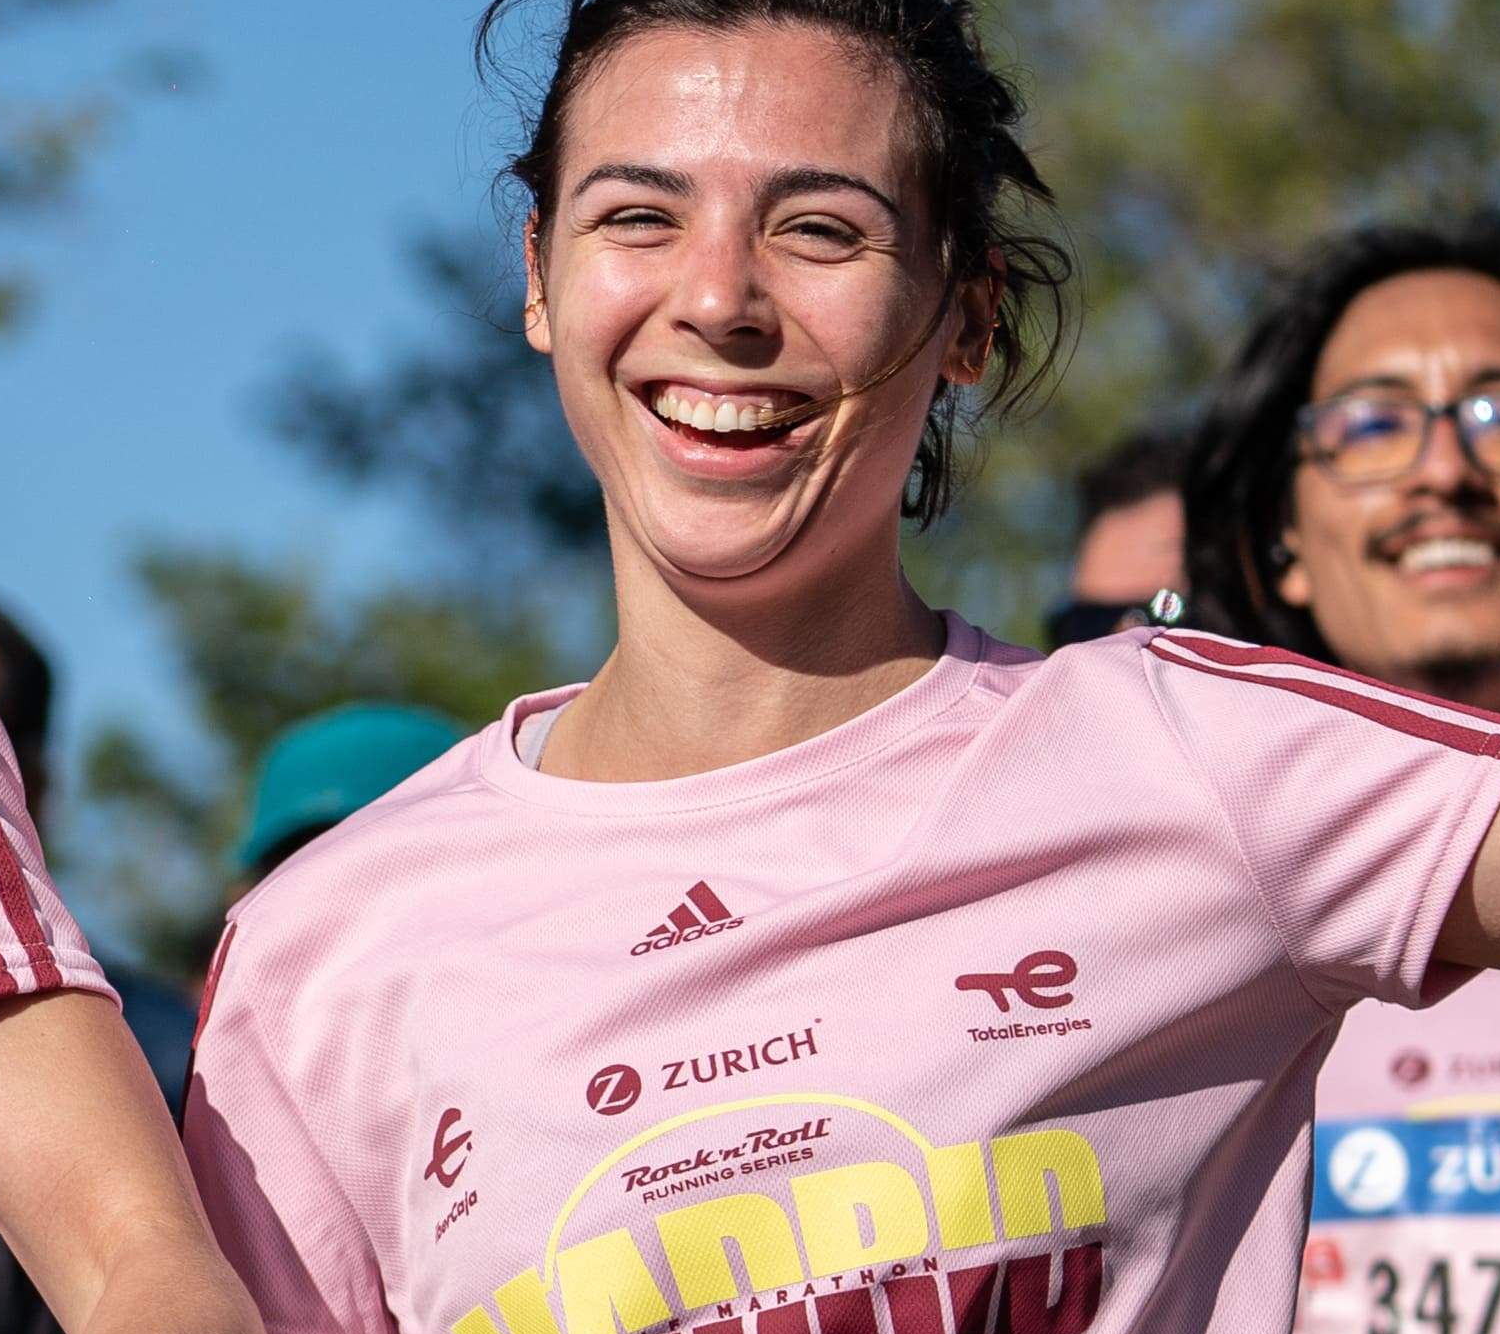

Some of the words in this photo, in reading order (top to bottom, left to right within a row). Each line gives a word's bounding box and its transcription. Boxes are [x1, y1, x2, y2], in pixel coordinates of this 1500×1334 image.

[630, 917, 745, 957] adidas
[967, 1016, 1093, 1044] TotalEnergies
[660, 1027, 818, 1091] ZURICH
[642, 1168, 735, 1204] RUNNING
[740, 1147, 814, 1175] SERIES
[716, 1257, 939, 1319] MARATHON
